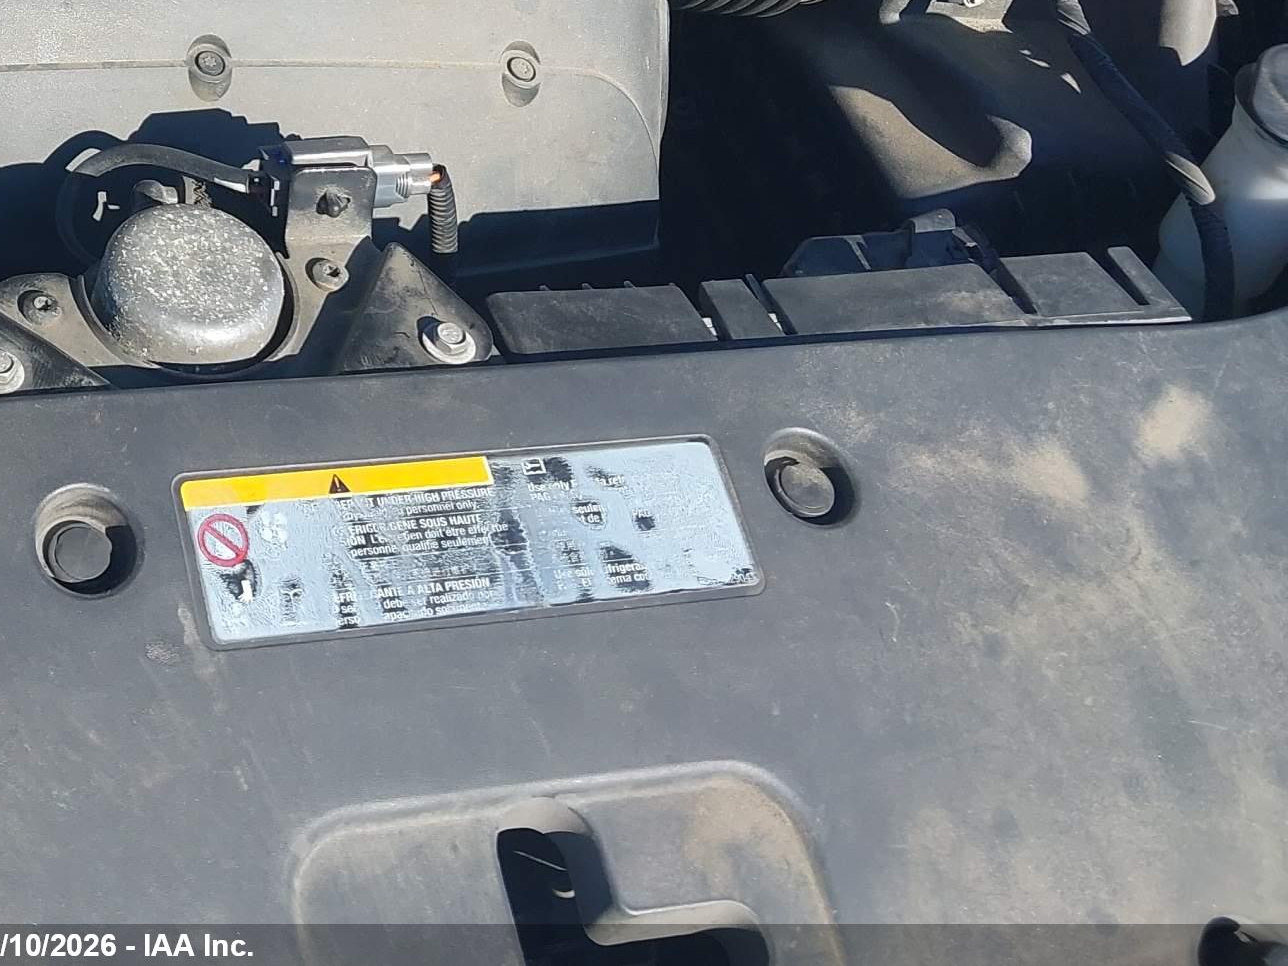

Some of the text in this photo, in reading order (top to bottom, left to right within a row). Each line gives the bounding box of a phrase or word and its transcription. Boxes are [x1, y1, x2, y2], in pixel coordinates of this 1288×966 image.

[441, 486, 496, 502] PRESSURE
[527, 483, 546, 492] Use
[405, 501, 455, 517] personnel
[419, 517, 448, 529] SOUS
[449, 513, 484, 526] HAUTE
[425, 528, 445, 539] doit
[407, 584, 416, 596] A
[417, 582, 443, 595] ALTA
[444, 576, 491, 591] PRESIÓN
[429, 590, 475, 604] realizado
